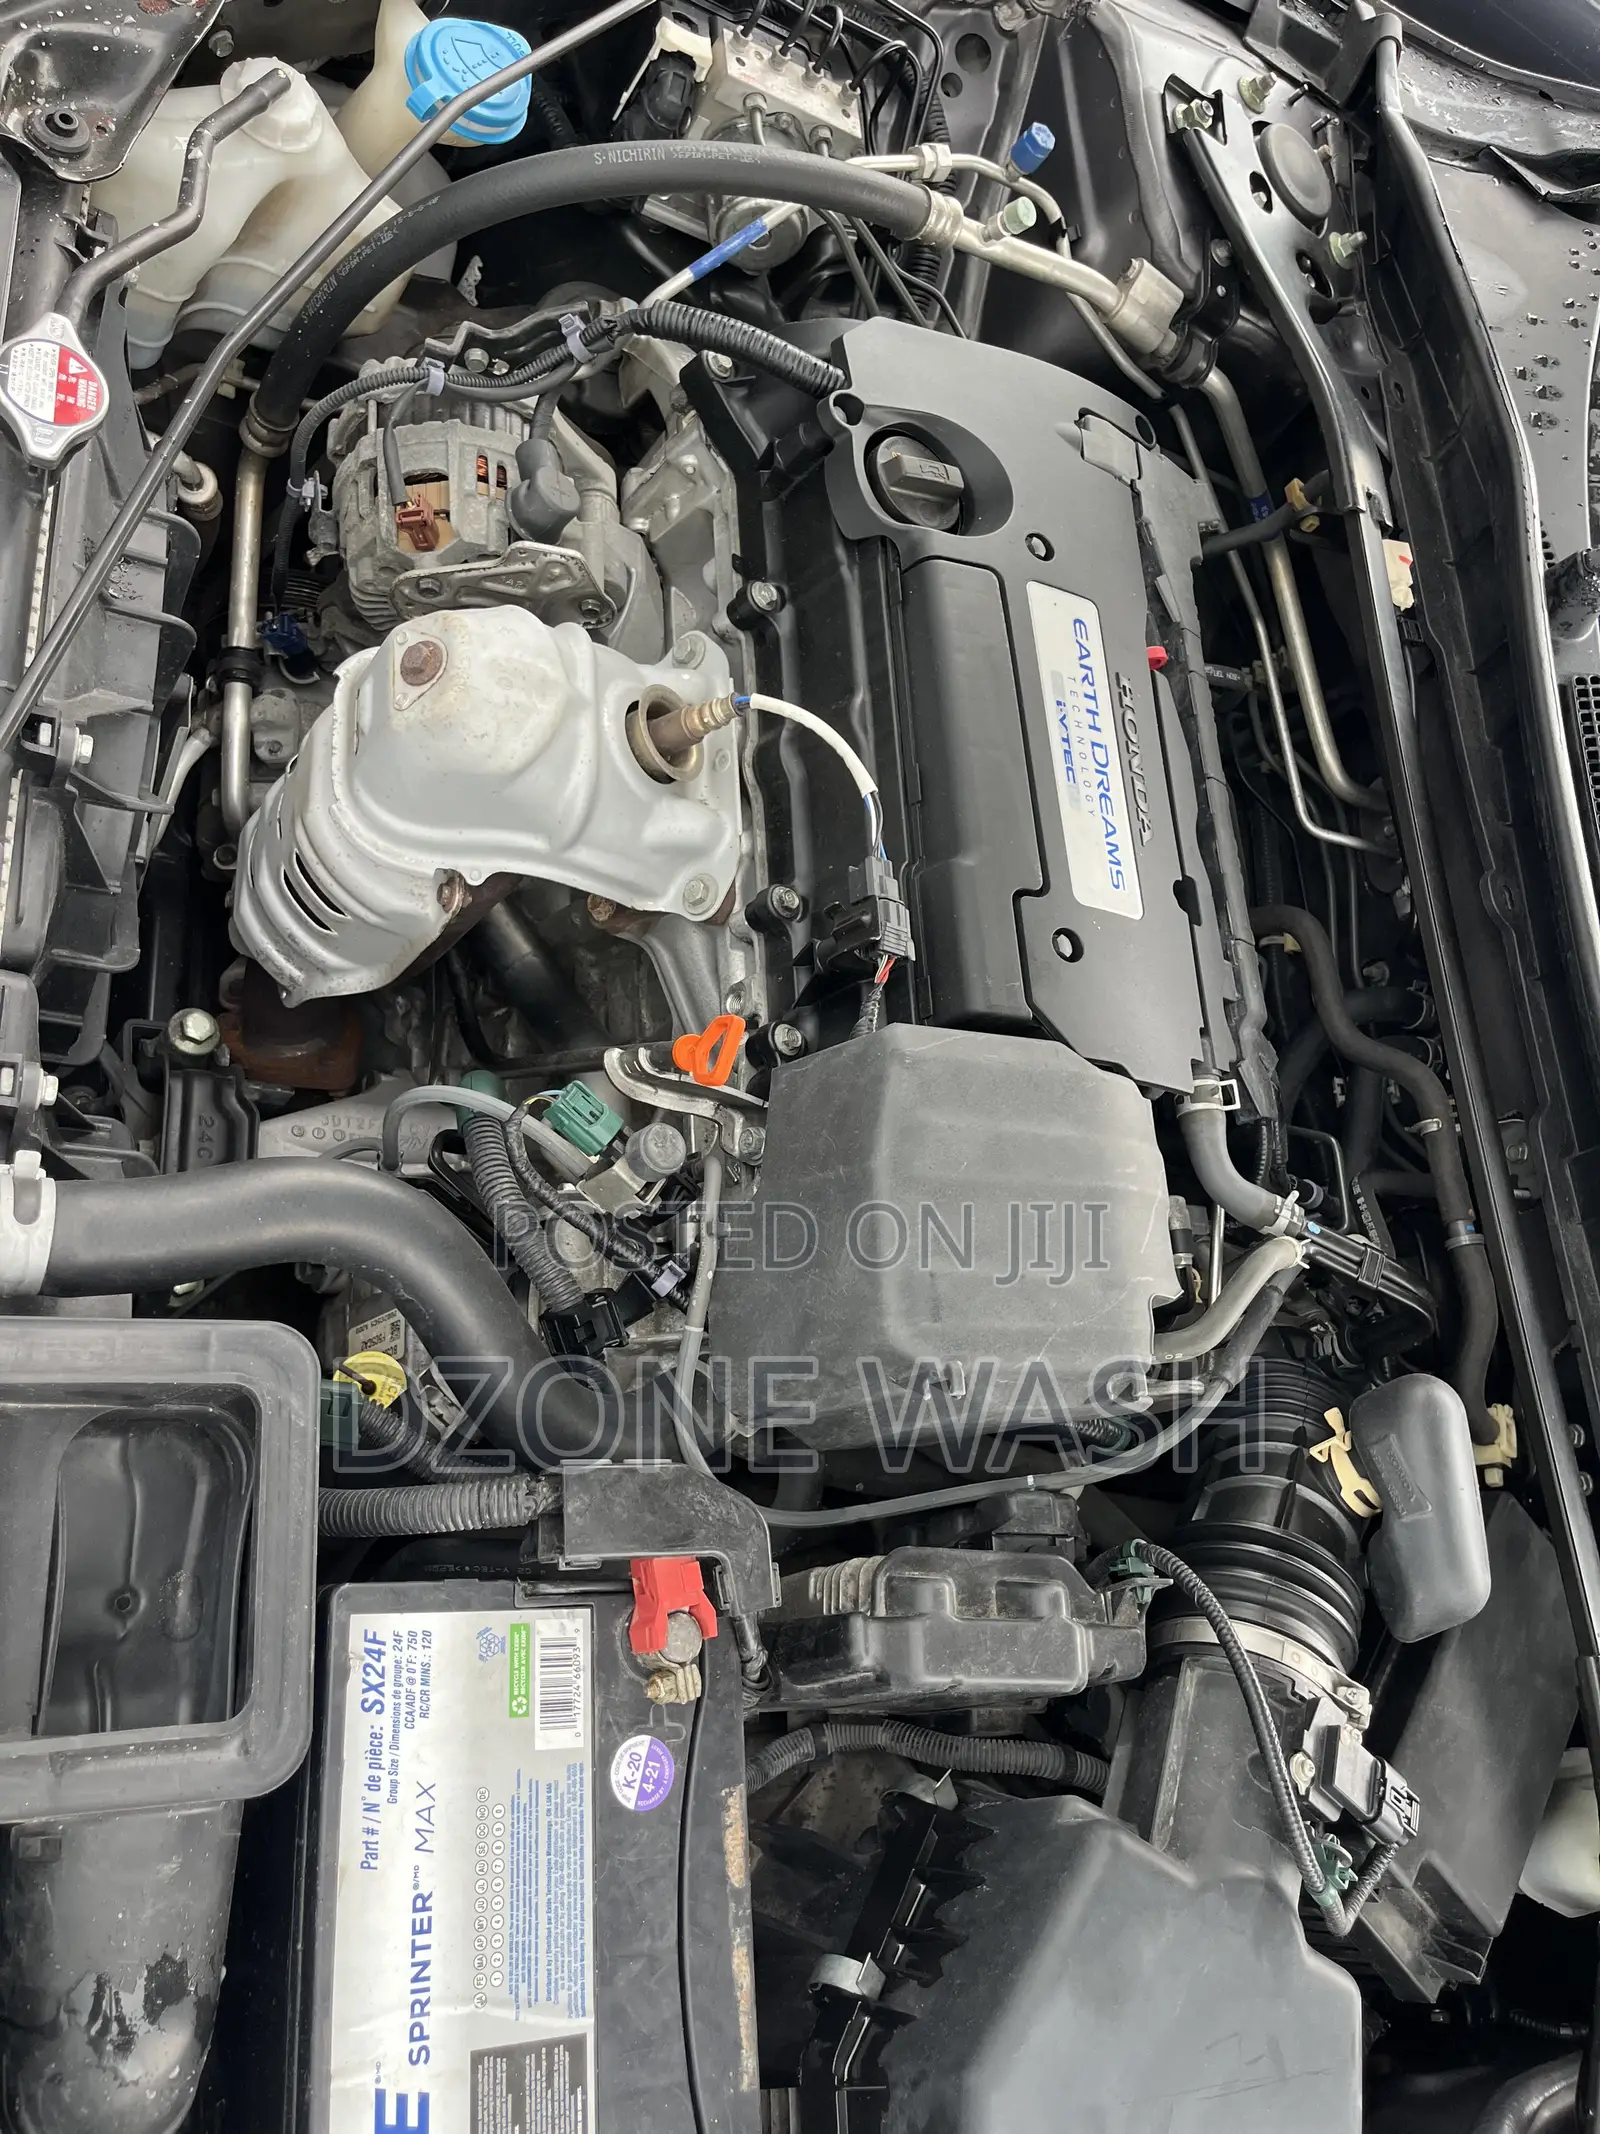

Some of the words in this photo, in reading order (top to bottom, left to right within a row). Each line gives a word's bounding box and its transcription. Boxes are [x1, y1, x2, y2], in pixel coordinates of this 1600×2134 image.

[87, 381, 98, 411] DANGER
[1067, 675, 1096, 819] TECHNOLOGY
[1073, 618, 1102, 733] EARTH
[1090, 741, 1126, 892] DREAMS
[1114, 672, 1154, 847] HONDA
[392, 1630, 403, 1652] 24F
[407, 1631, 417, 1651] 750
[421, 1630, 432, 1650] 120
[361, 1629, 386, 1715] SX24F
[393, 1656, 404, 1688] groupe:
[573, 1646, 581, 1680] 66093
[392, 1690, 401, 1700] de
[406, 1676, 416, 1686] @
[405, 1688, 416, 1730] CCA/ADF
[419, 1689, 430, 1719] RC/CR
[573, 1685, 581, 1717] 17724
[388, 1702, 401, 1751] Dimensions
[366, 1725, 385, 1770] pièce:
[364, 1775, 381, 1792] de
[388, 1759, 399, 1776] Size
[622, 1752, 642, 1790] K-20
[642, 1760, 661, 1793] 4-21
[387, 1779, 400, 1804] Group
[362, 1815, 381, 1824] /
[362, 1826, 373, 1836] #
[415, 1780, 436, 1853] MAX
[360, 1841, 379, 1870] Part
[408, 1891, 434, 2066] SPRINTER
